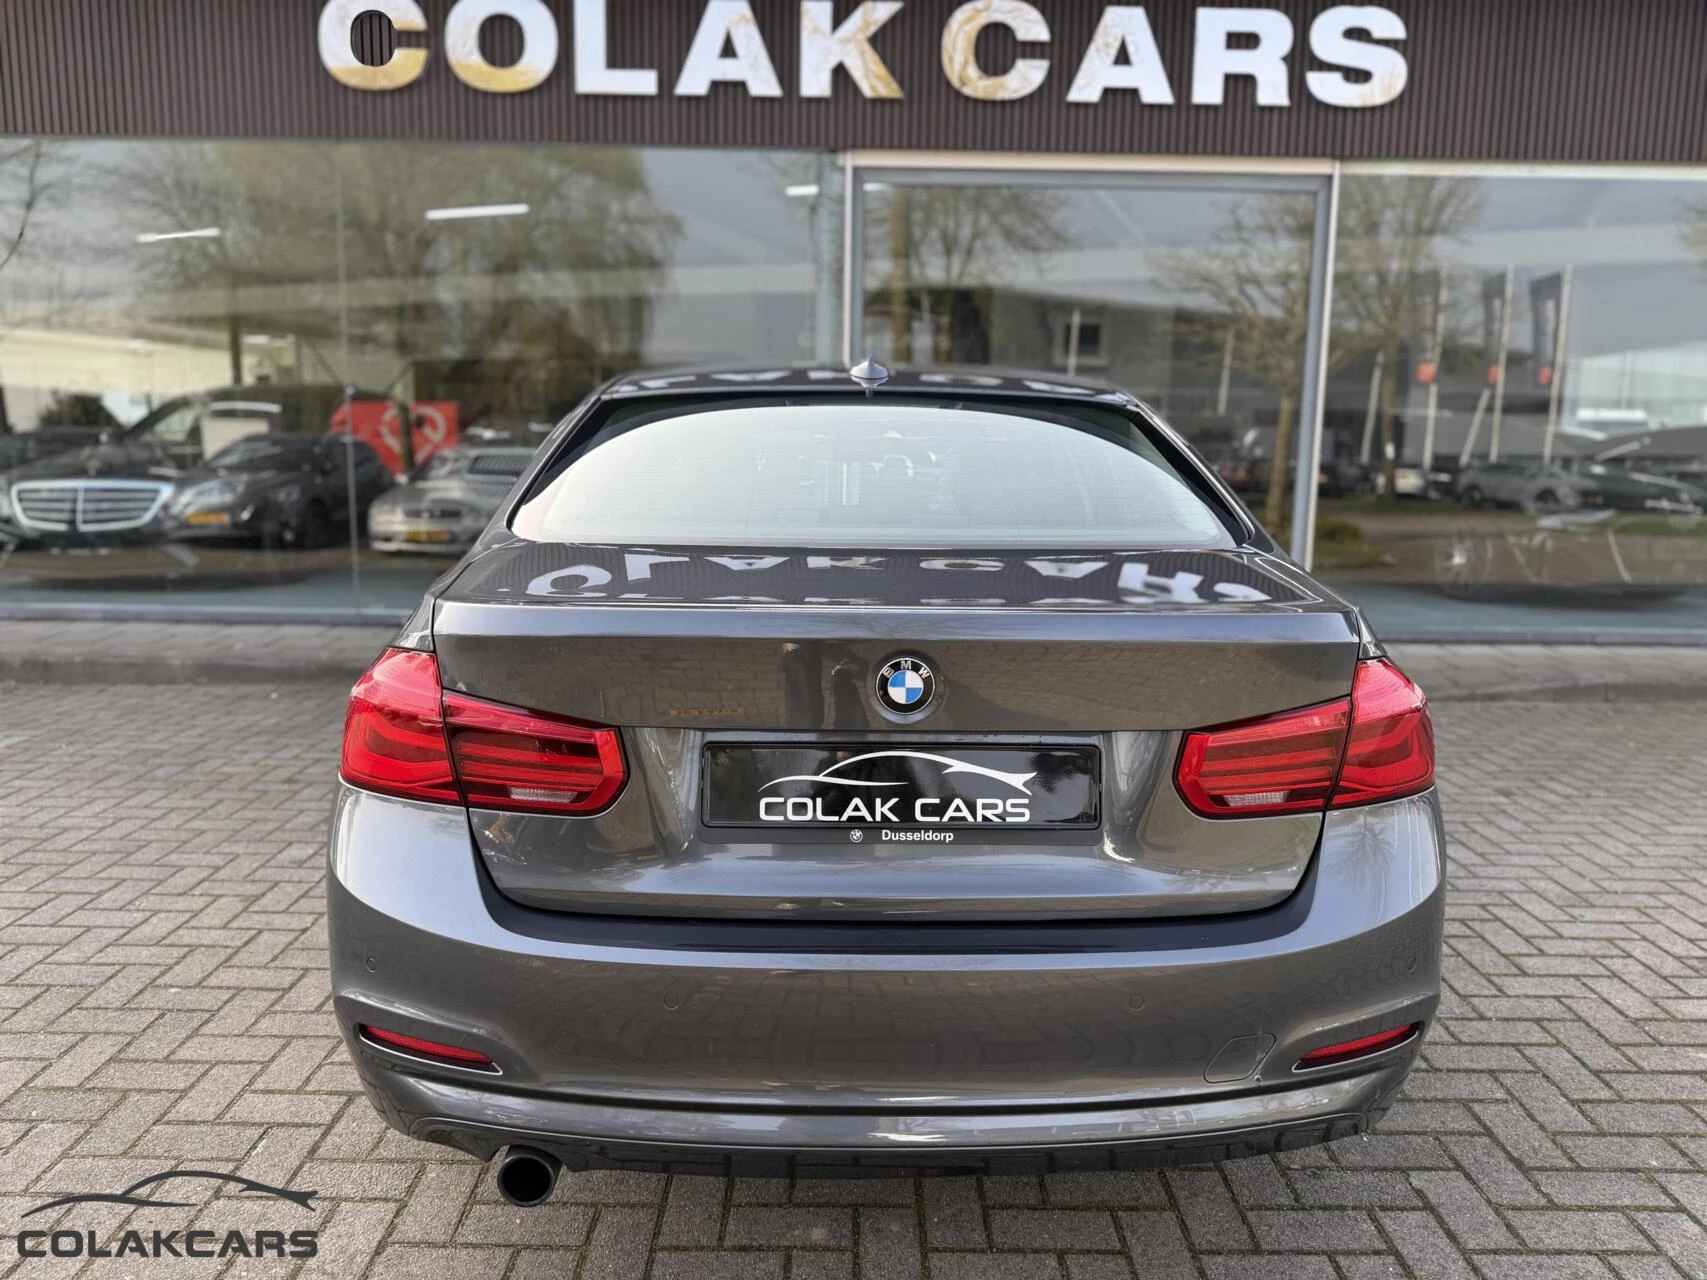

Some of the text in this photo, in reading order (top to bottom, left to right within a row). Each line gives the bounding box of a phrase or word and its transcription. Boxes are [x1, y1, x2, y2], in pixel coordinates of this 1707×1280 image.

[318, 0, 1408, 107] COLAK CARS
[882, 659, 931, 679] BMW
[759, 797, 1031, 823] COLAK CARS
[881, 829, 954, 844] Dusseldorp
